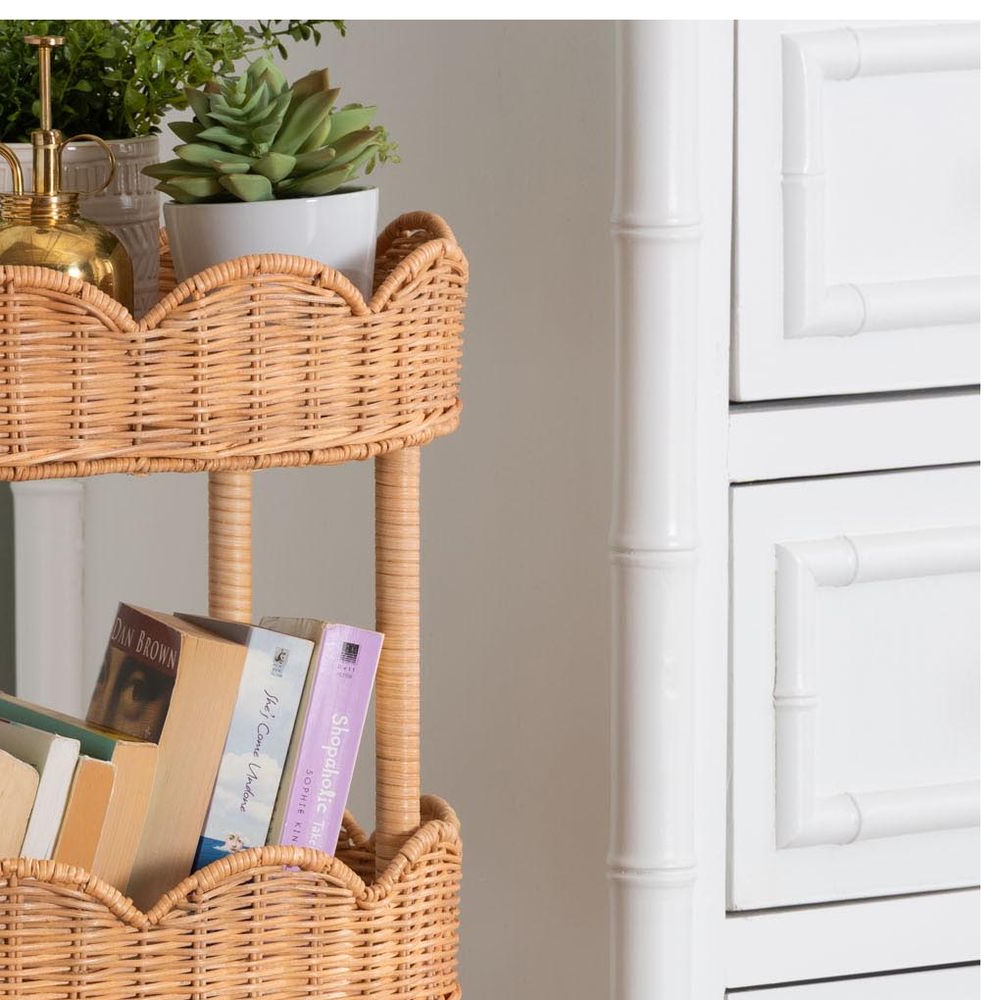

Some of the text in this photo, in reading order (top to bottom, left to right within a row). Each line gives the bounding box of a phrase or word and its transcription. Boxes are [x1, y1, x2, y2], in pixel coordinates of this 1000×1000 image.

[111, 617, 177, 669] DAN BROWN
[252, 722, 270, 758] Come
[316, 713, 349, 814] Shopaholic
[240, 762, 262, 812] Undone
[297, 768, 314, 814] SOPHIE
